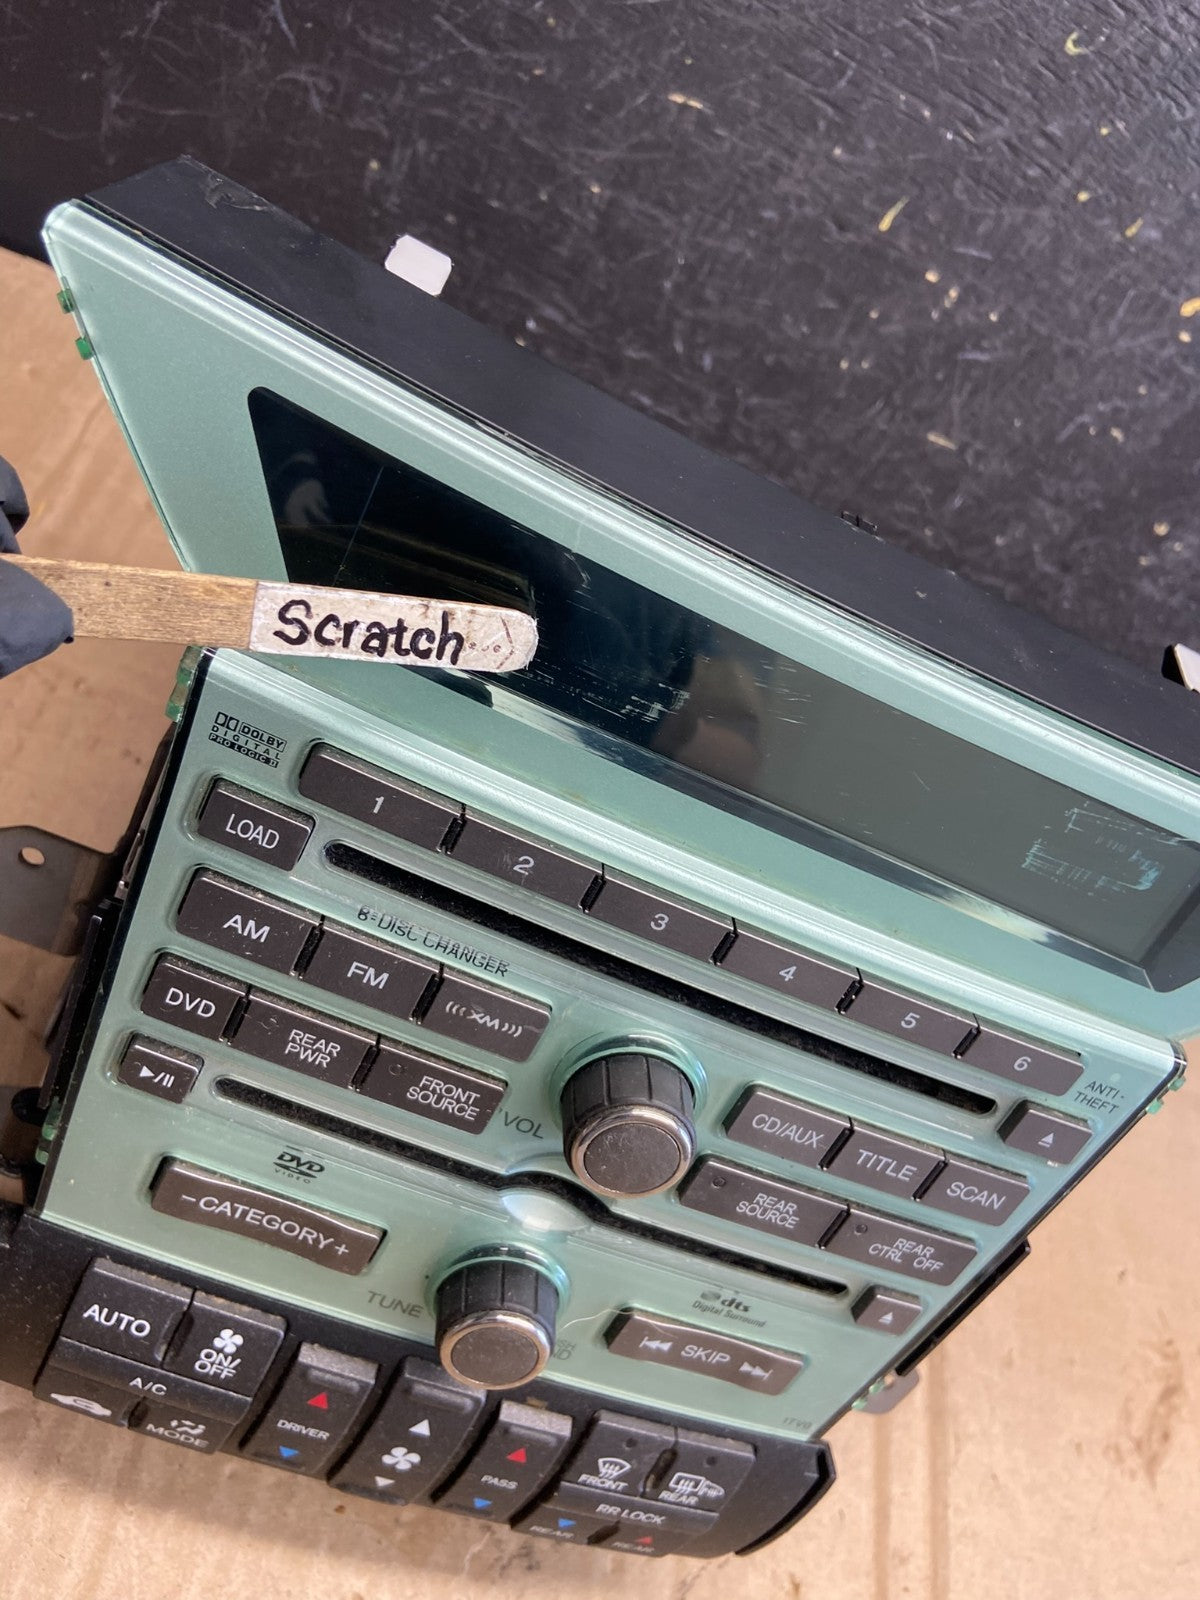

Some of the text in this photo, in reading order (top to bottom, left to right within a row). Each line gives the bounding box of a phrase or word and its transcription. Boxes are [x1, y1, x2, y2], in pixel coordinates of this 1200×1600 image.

[273, 599, 464, 666] Scratch
[210, 734, 231, 747] PRO
[234, 744, 267, 763] LOGIC
[211, 725, 281, 760] DIGITAL
[241, 725, 284, 749] DOLBY
[373, 796, 385, 814] 1
[226, 813, 280, 850] LOAD
[513, 855, 534, 875] 2
[223, 913, 270, 943] AM
[651, 913, 669, 932] 3
[423, 931, 510, 977] CHANGER
[346, 961, 390, 990] FM
[779, 965, 797, 983] 4
[165, 986, 216, 1019] DVD
[901, 1012, 920, 1030] 5
[288, 1028, 341, 1058] REAR
[284, 1043, 331, 1069] PWR
[1013, 1056, 1030, 1073] 6
[419, 1074, 480, 1104] FRONT
[406, 1085, 480, 1122] SOURCE
[1074, 1090, 1120, 1115] THEFT
[504, 1110, 544, 1140] VOL
[751, 1113, 825, 1150] CD/AUX
[277, 1151, 325, 1173] DVD
[856, 1148, 917, 1183] TITLE
[751, 1191, 798, 1215] REAR
[946, 1181, 1006, 1210] SCAN
[736, 1200, 800, 1230] SOURCE
[868, 1242, 944, 1274] CTRL OFF
[893, 1237, 934, 1259] REAR
[367, 1290, 423, 1319] TUNE
[692, 1300, 723, 1317] Digital
[720, 1298, 751, 1313] dts
[82, 1303, 151, 1338] AUTO
[200, 1348, 242, 1369] ON/
[680, 1343, 732, 1366] SKIP
[194, 1360, 236, 1381] OFF
[128, 1376, 168, 1396] A/C
[145, 1422, 209, 1449] MODE
[276, 1418, 330, 1442] DRIVER
[480, 1474, 518, 1491] PASS
[577, 1473, 629, 1491] FRONT
[658, 1489, 700, 1505] REAR
[596, 1503, 666, 1525] RR LOCK
[529, 1525, 575, 1539] REAR
[611, 1541, 656, 1553] REAR
